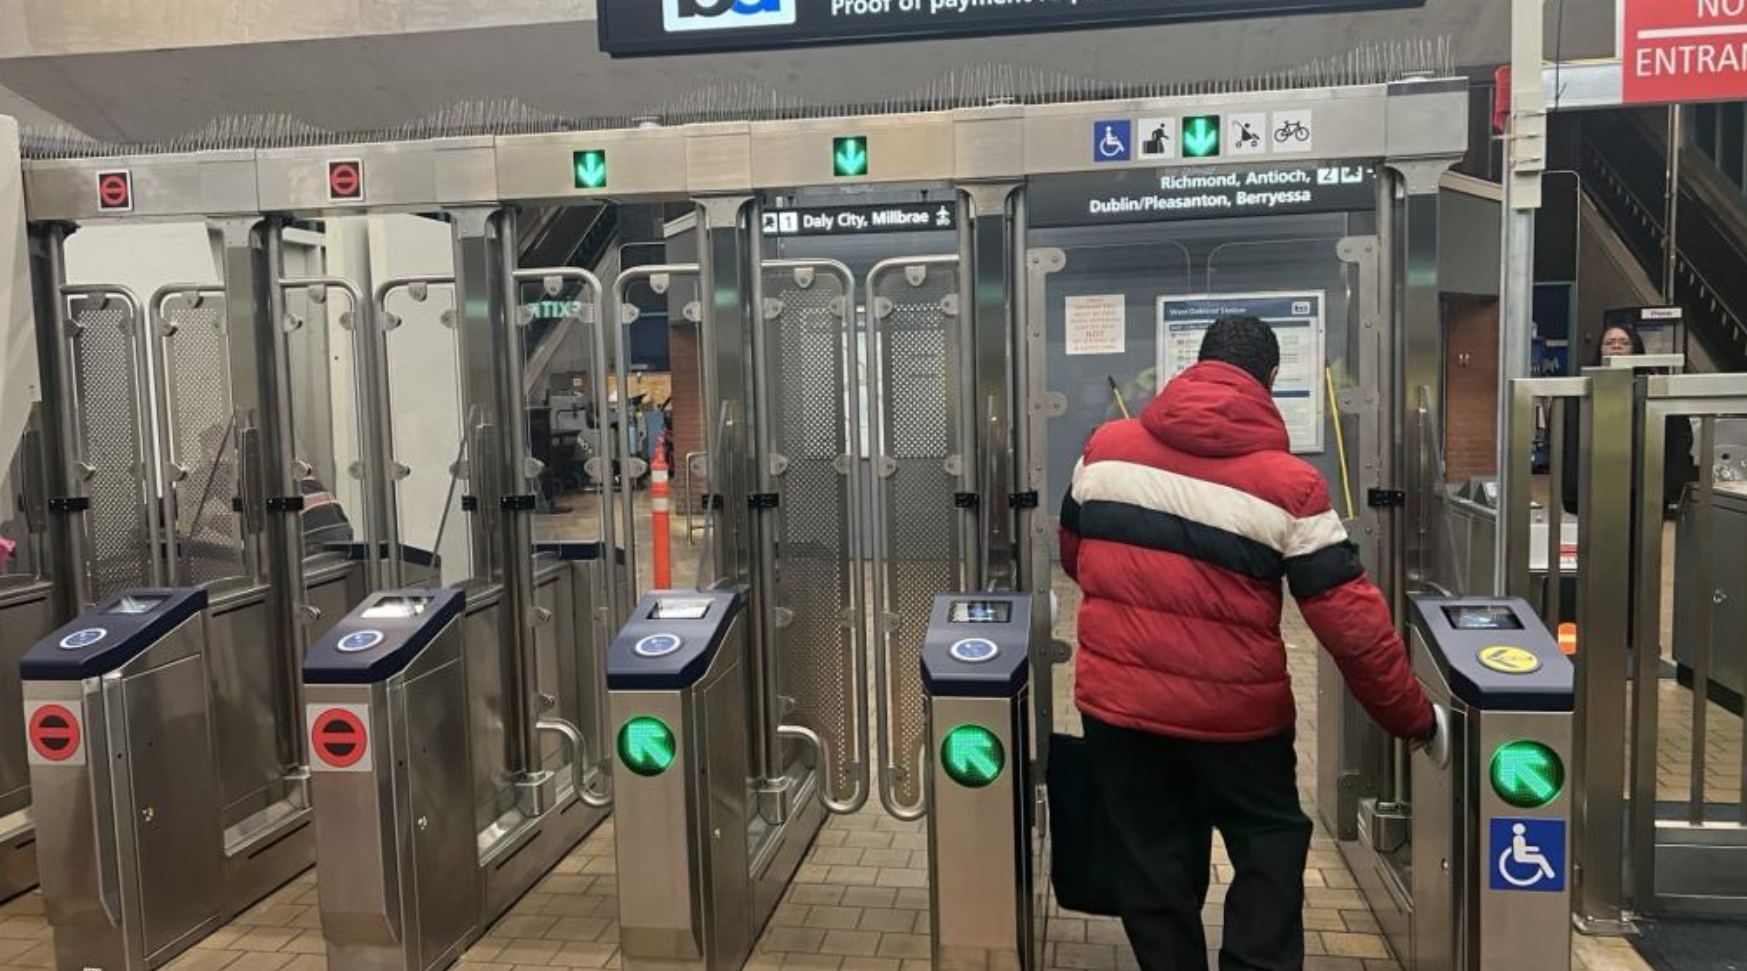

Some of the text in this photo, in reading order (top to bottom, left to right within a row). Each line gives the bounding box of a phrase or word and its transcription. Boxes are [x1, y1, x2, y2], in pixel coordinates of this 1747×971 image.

[832, 0, 890, 15] Proof
[1698, 0, 1745, 18] NO
[1636, 43, 1747, 77] ENTRA
[1160, 175, 1241, 190] Richmond,
[1245, 171, 1310, 186] Antioch,
[1089, 190, 1311, 213] Dublin/Pleasanton, Berryessa
[803, 213, 834, 230] Daly
[837, 211, 868, 229] City,
[872, 210, 930, 226] Millbrae
